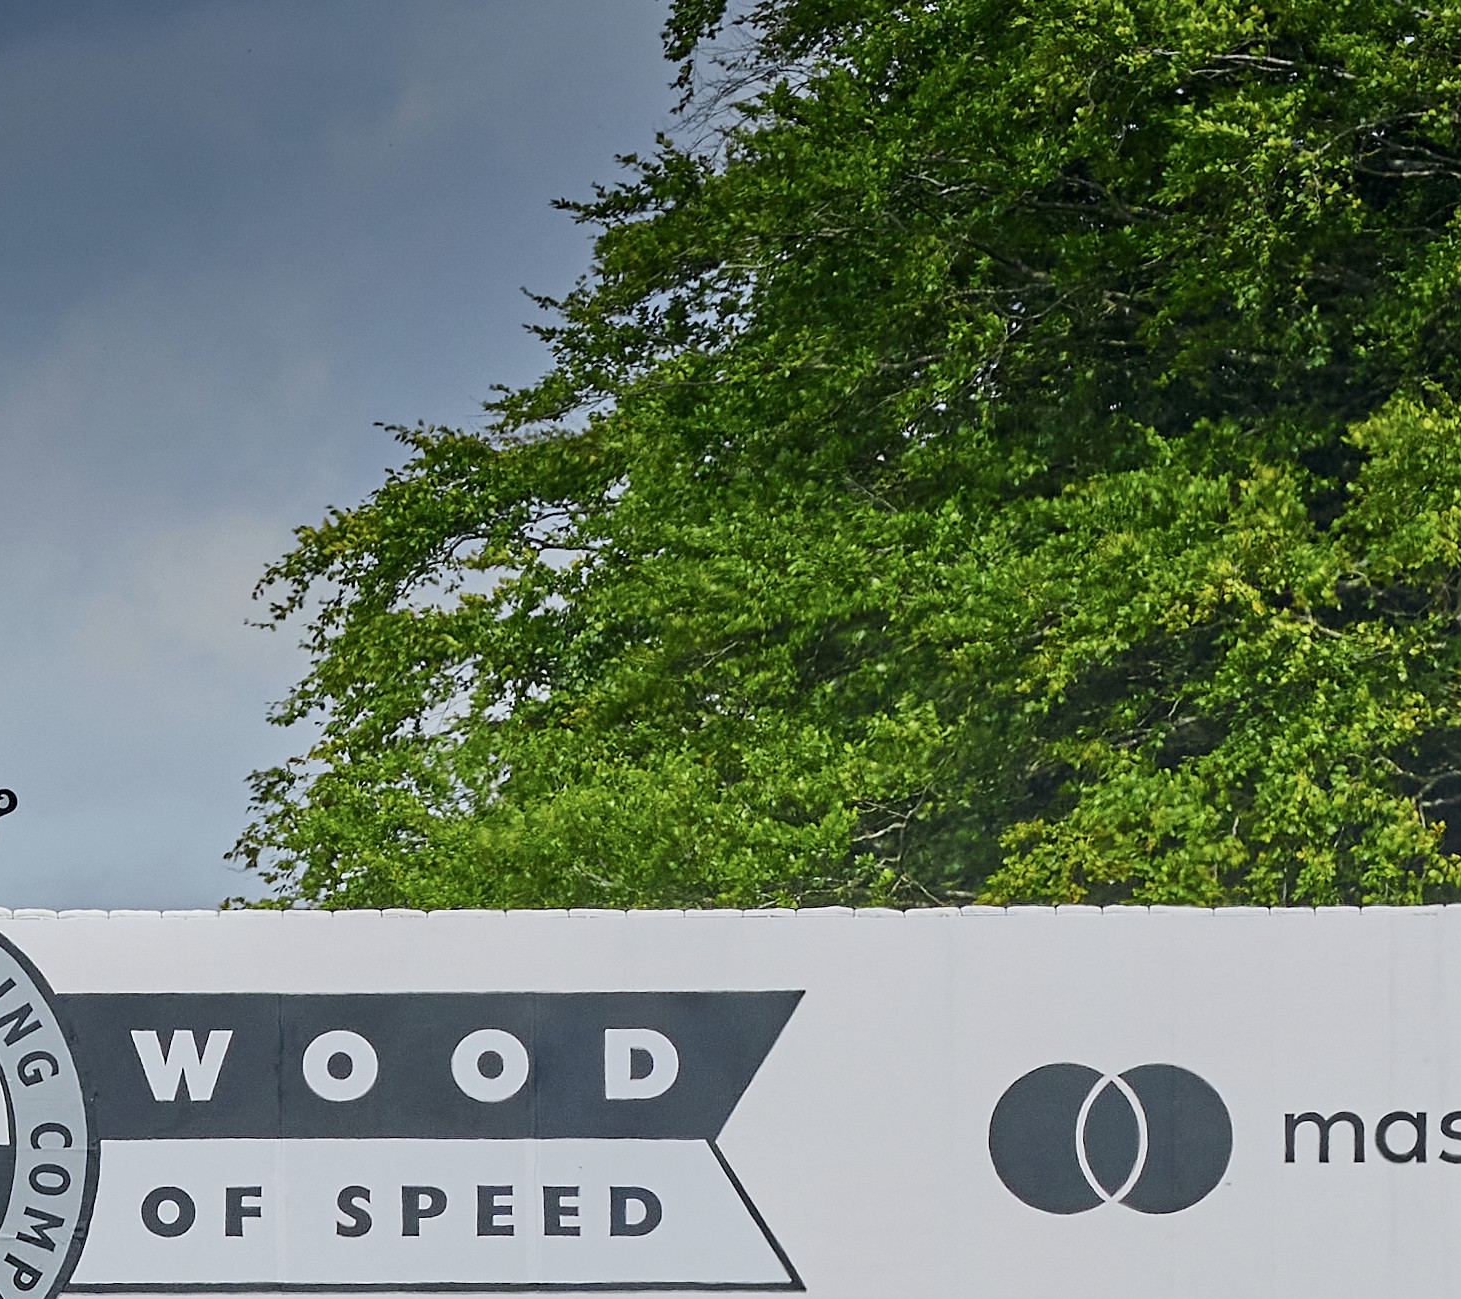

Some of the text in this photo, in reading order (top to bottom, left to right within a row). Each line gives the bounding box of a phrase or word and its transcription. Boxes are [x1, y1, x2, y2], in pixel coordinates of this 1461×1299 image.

[130, 1028, 680, 1102] WOOD
[141, 1185, 264, 1238] OF
[335, 1184, 664, 1238] SPEED
